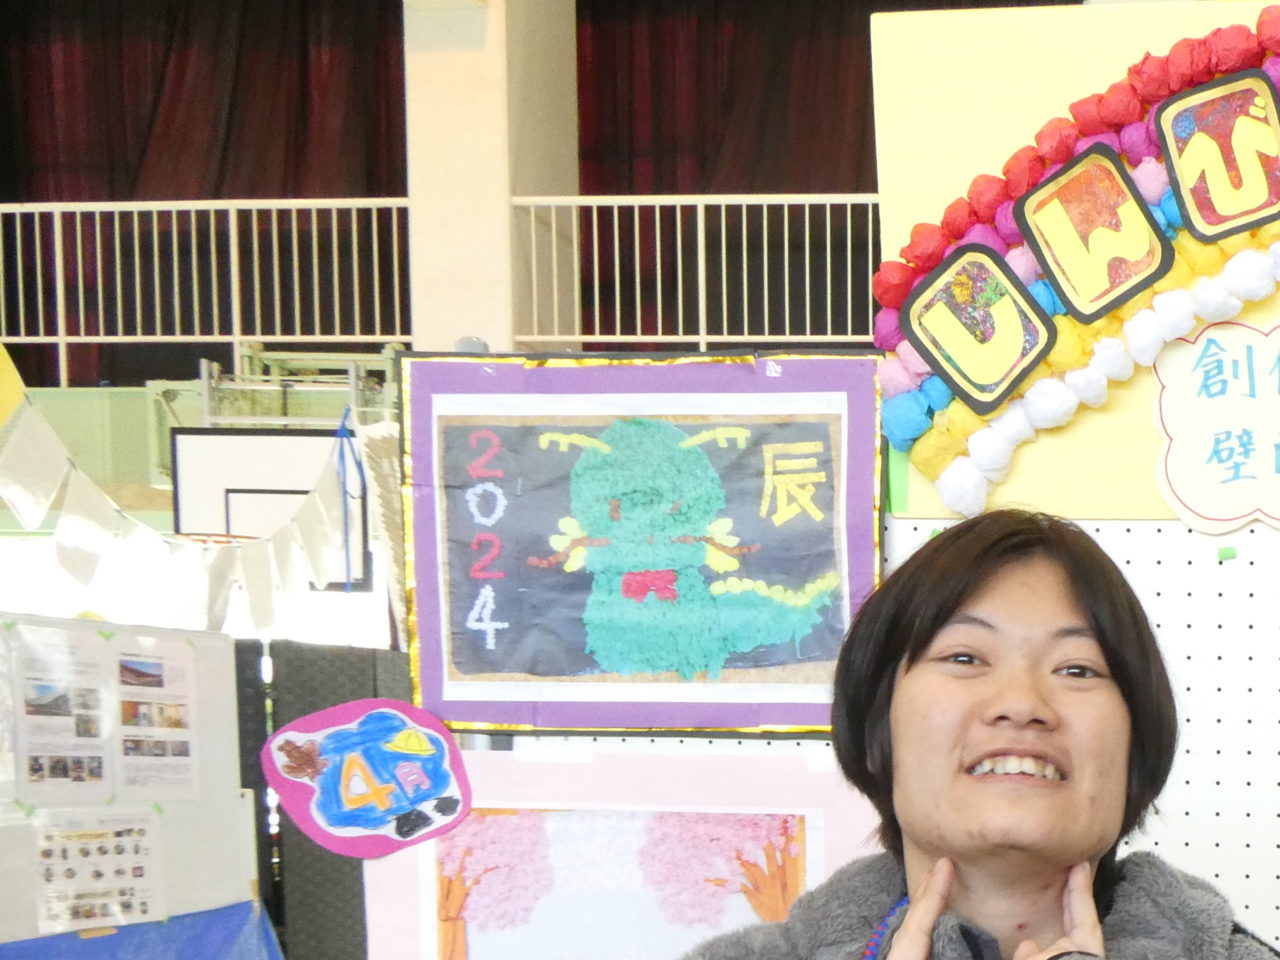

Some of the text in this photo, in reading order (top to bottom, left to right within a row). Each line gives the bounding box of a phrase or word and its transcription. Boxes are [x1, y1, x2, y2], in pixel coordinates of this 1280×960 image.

[759, 441, 827, 527] 辰
[464, 427, 510, 650] 2024
[340, 751, 432, 812] 4月
